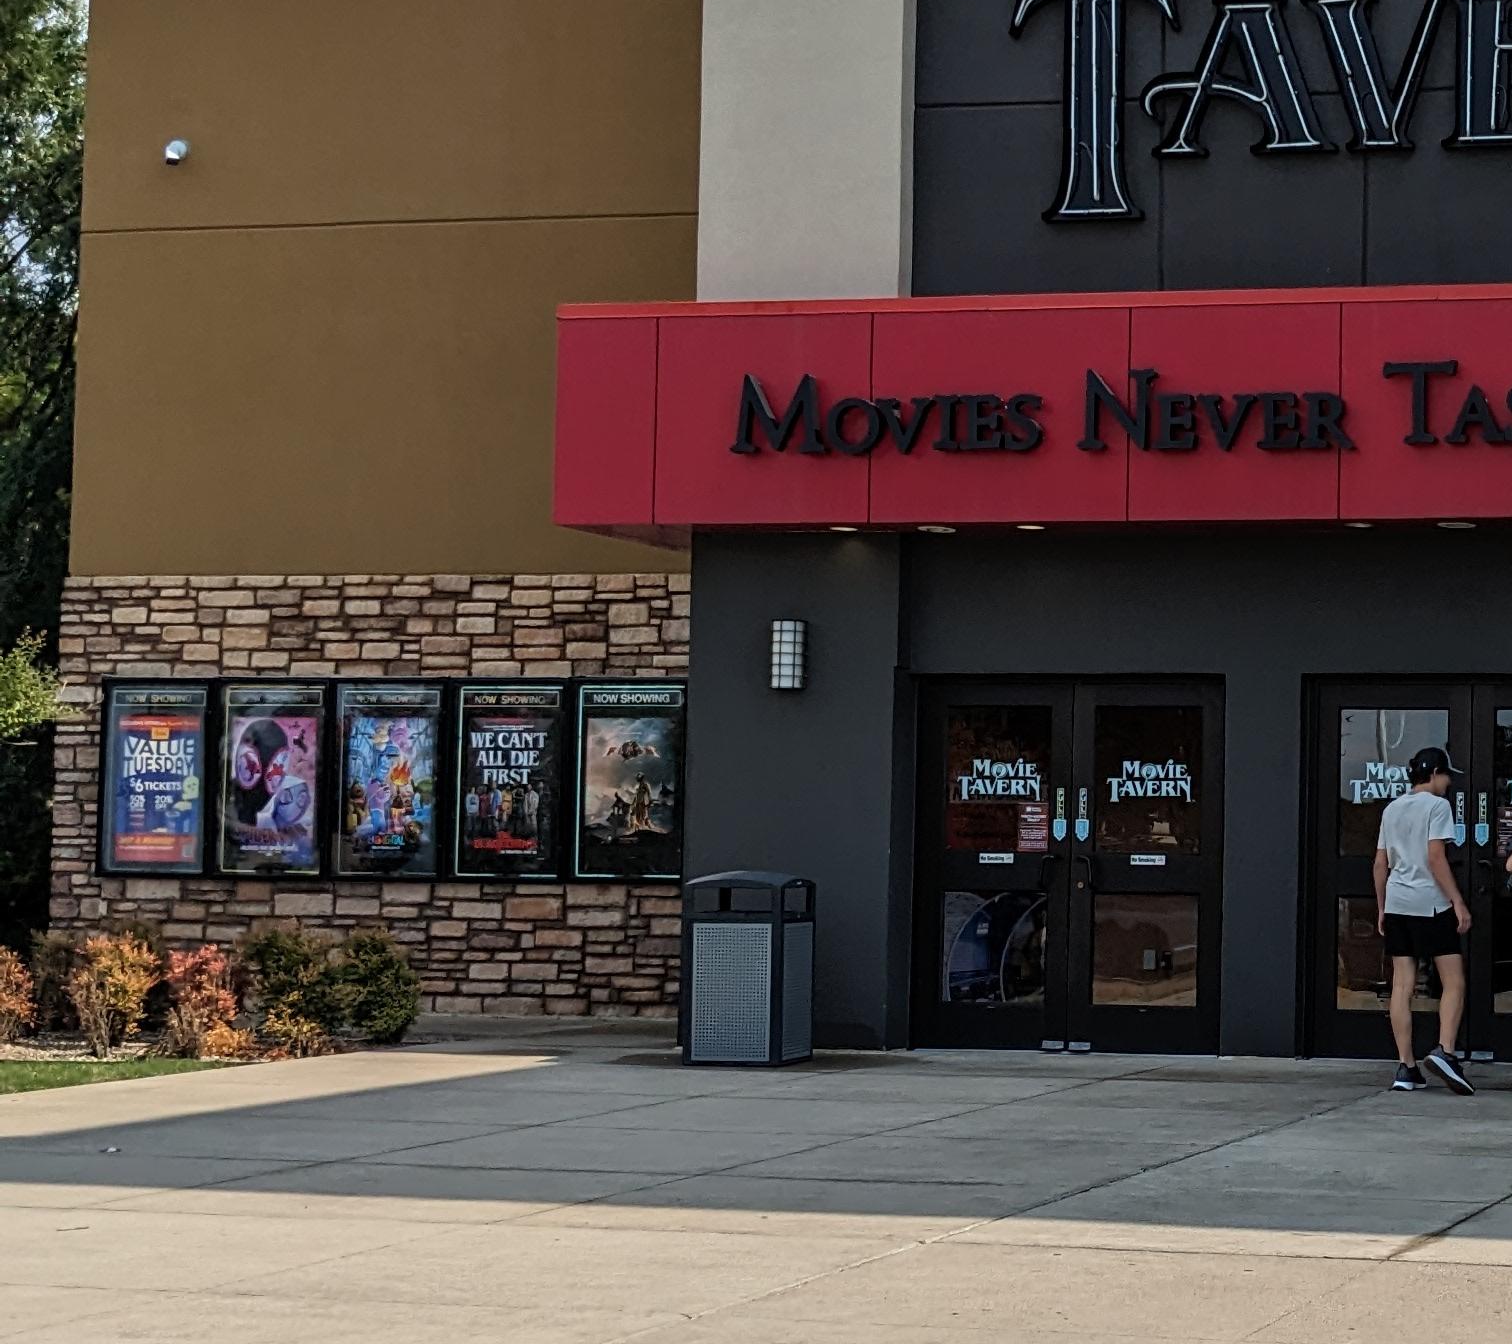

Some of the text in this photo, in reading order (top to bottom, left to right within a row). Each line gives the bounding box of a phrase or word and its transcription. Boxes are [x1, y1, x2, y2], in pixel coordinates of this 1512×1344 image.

[474, 695, 546, 705] NOW SHOWING
[593, 693, 670, 704] NOW SHOWING
[125, 736, 195, 756] VALUE
[471, 731, 548, 749] WE CAN'T
[124, 755, 195, 774] TUESDAY
[476, 750, 540, 767] ALL DIE
[482, 768, 532, 785] FIRST
[957, 775, 1041, 801] TAVERN
[1106, 776, 1191, 803] TAVERN
